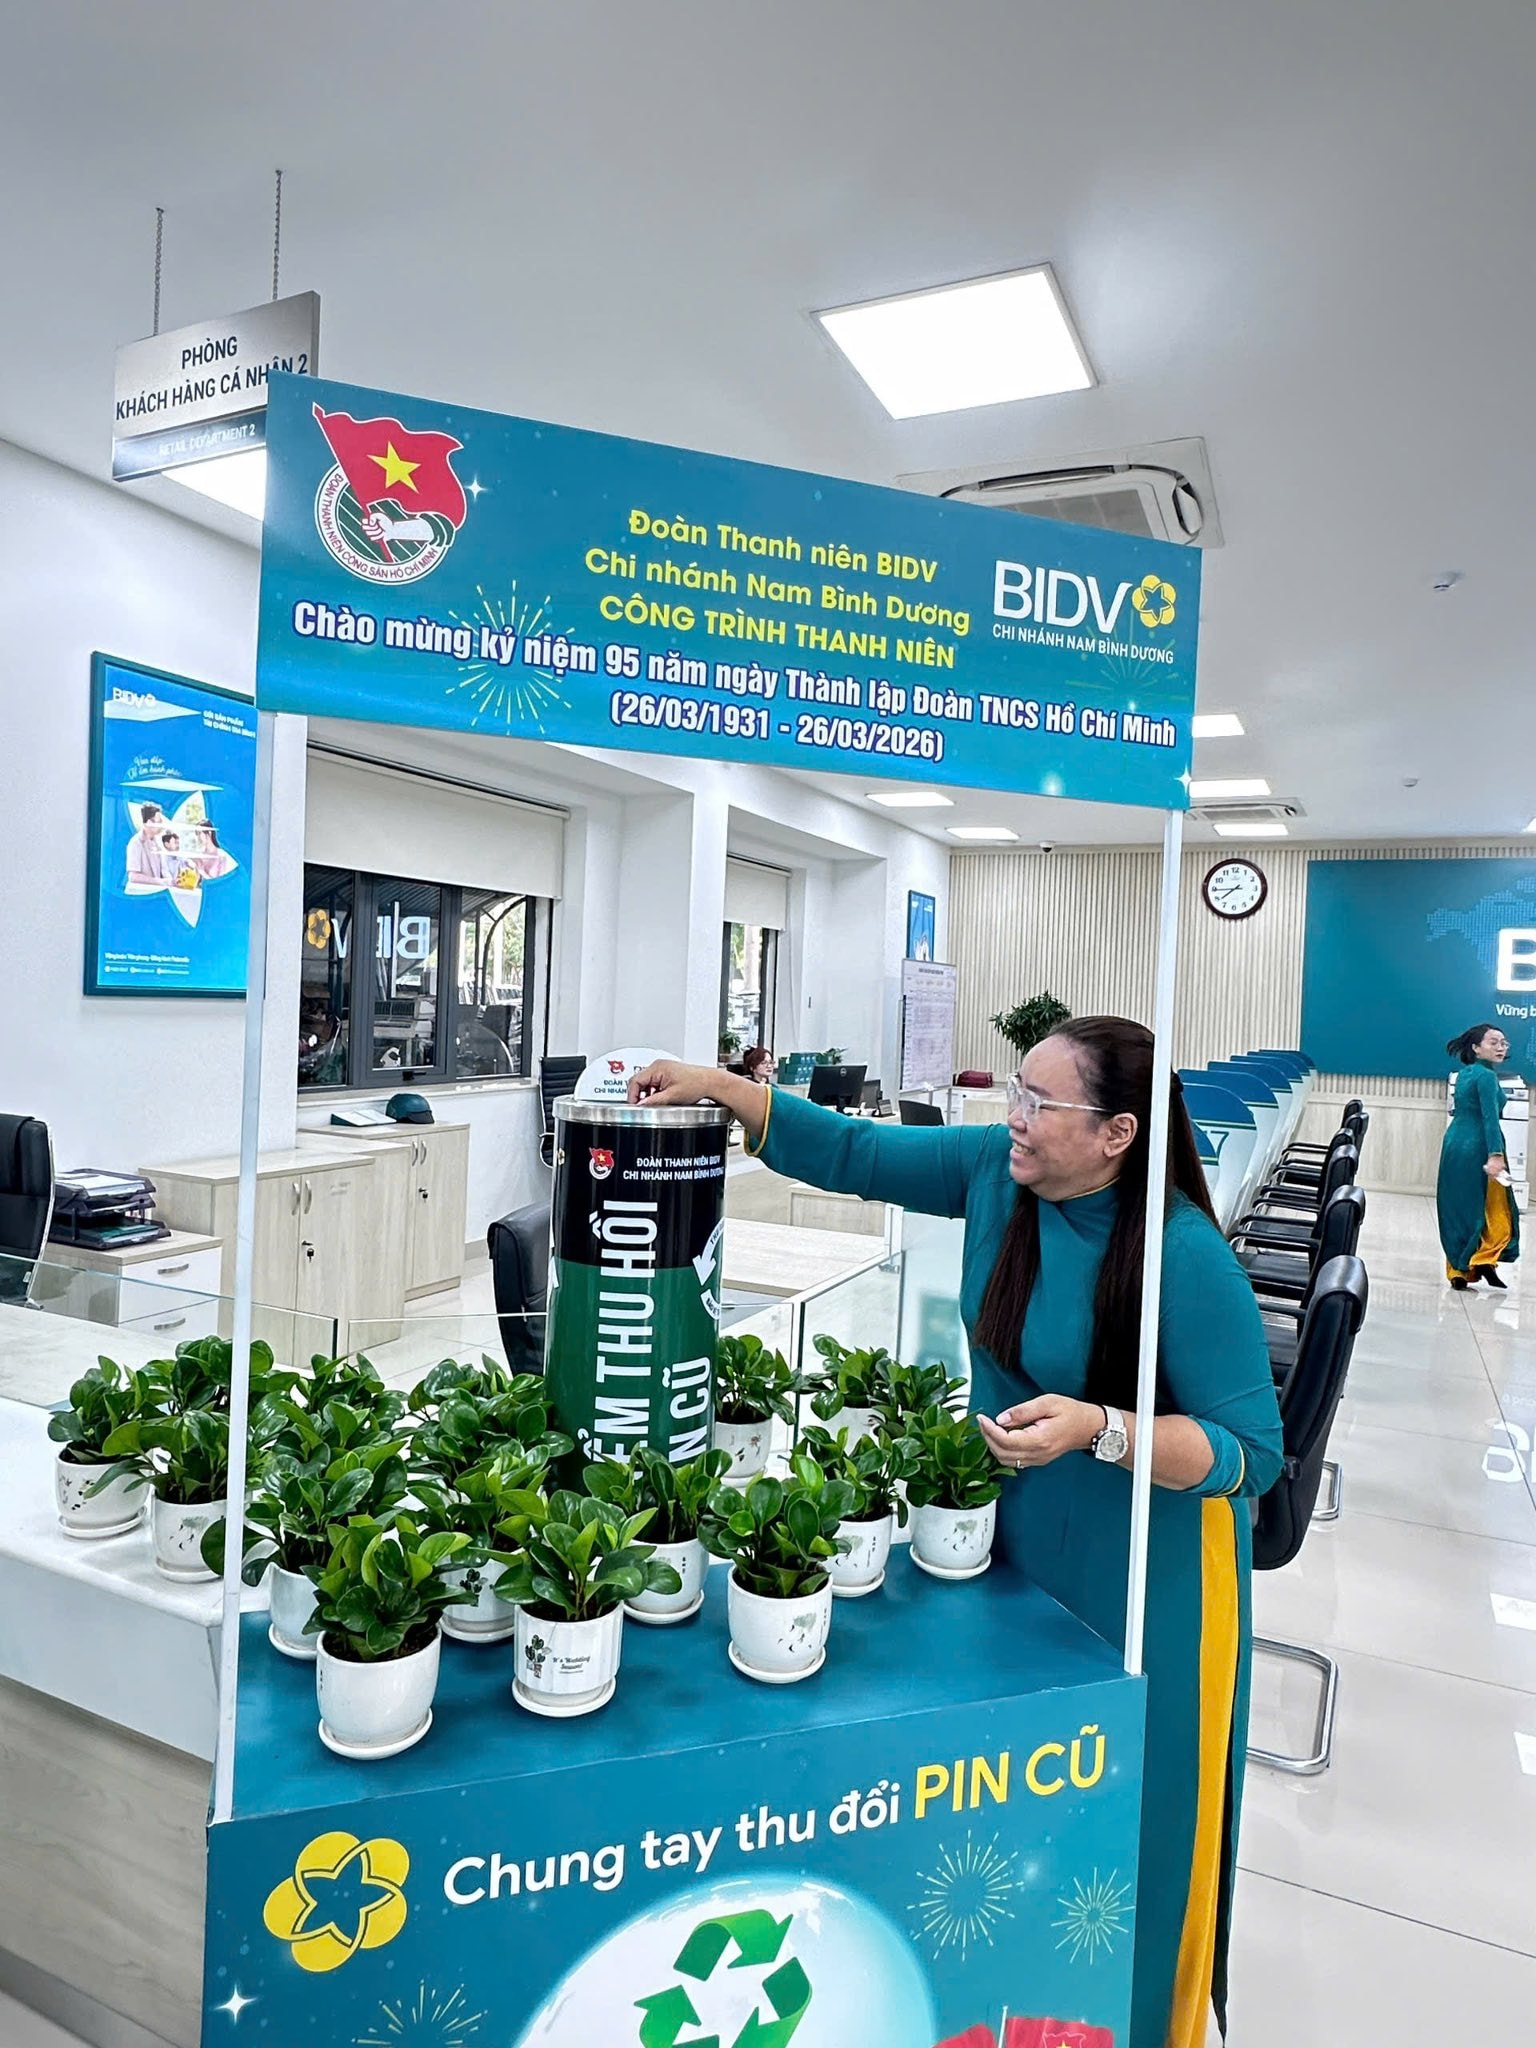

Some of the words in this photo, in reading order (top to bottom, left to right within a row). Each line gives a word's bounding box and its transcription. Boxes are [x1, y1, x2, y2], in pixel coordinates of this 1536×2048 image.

[116, 391, 168, 421] KHÁCH
[172, 379, 216, 407] HÀNG
[220, 366, 241, 394] CÁ
[298, 353, 308, 374] 2
[182, 336, 238, 369] PHÒNG
[249, 423, 255, 437] 2
[321, 499, 334, 530] THANH
[404, 561, 421, 576] CHÍ
[418, 548, 439, 568] MINH
[629, 509, 707, 546] Đoàn
[717, 524, 801, 561] Thanh
[811, 544, 868, 572] niên
[877, 552, 938, 583] BIDV
[585, 548, 636, 579] Chi
[646, 560, 737, 594] nhánh
[747, 573, 811, 606] Nam
[821, 584, 878, 616] Bình
[886, 595, 970, 637] Dương
[993, 560, 1133, 634] BIDV
[600, 592, 696, 631] CÔNG
[704, 607, 786, 645] TRÌNH
[795, 623, 887, 659] THANH
[896, 636, 954, 669] NIÊN
[992, 623, 1015, 640] CHI
[1018, 627, 1064, 648] NHÁNH
[1067, 635, 1095, 653] NAM
[1098, 637, 1128, 657] BÌNH
[1131, 645, 1174, 664] DƯƠNG
[112, 687, 146, 708] BIDV
[294, 600, 375, 644] Chào
[385, 615, 472, 660] mừng
[480, 625, 516, 665] kỷ
[523, 634, 596, 676] niệm
[605, 644, 640, 678] 95
[648, 651, 707, 687] năm
[715, 662, 779, 700] ngày
[785, 667, 860, 707] Thành
[868, 678, 907, 717] lập
[912, 685, 973, 722] Đoàn
[979, 694, 1040, 730] TNCS
[1045, 702, 1076, 735] Hồ
[1080, 708, 1116, 740] Chí
[1121, 713, 1177, 748] Minh
[610, 691, 769, 739] (26/03/1931
[777, 724, 791, 733] -
[796, 714, 945, 763] 26/03/2026)
[1496, 1003, 1528, 1019] Vững
[623, 1170, 639, 1180] CHI
[640, 1169, 672, 1181] NHÁNH
[674, 1170, 693, 1181] NAM
[694, 1168, 709, 1180] BÌNH
[636, 1155, 662, 1168] ĐOÀN
[664, 1157, 692, 1168] THANH
[693, 1155, 708, 1167] NIÊN
[589, 1200, 658, 1278] HỒI
[596, 1292, 656, 1384] THU
[662, 1355, 711, 1420] CŨ
[443, 1844, 626, 1906] Chung
[640, 1826, 722, 1872] tay
[735, 1804, 817, 1852] thu
[828, 1781, 901, 1835] đổi
[914, 1751, 1011, 1819] PIN
[1024, 1723, 1107, 1796] CŨ
